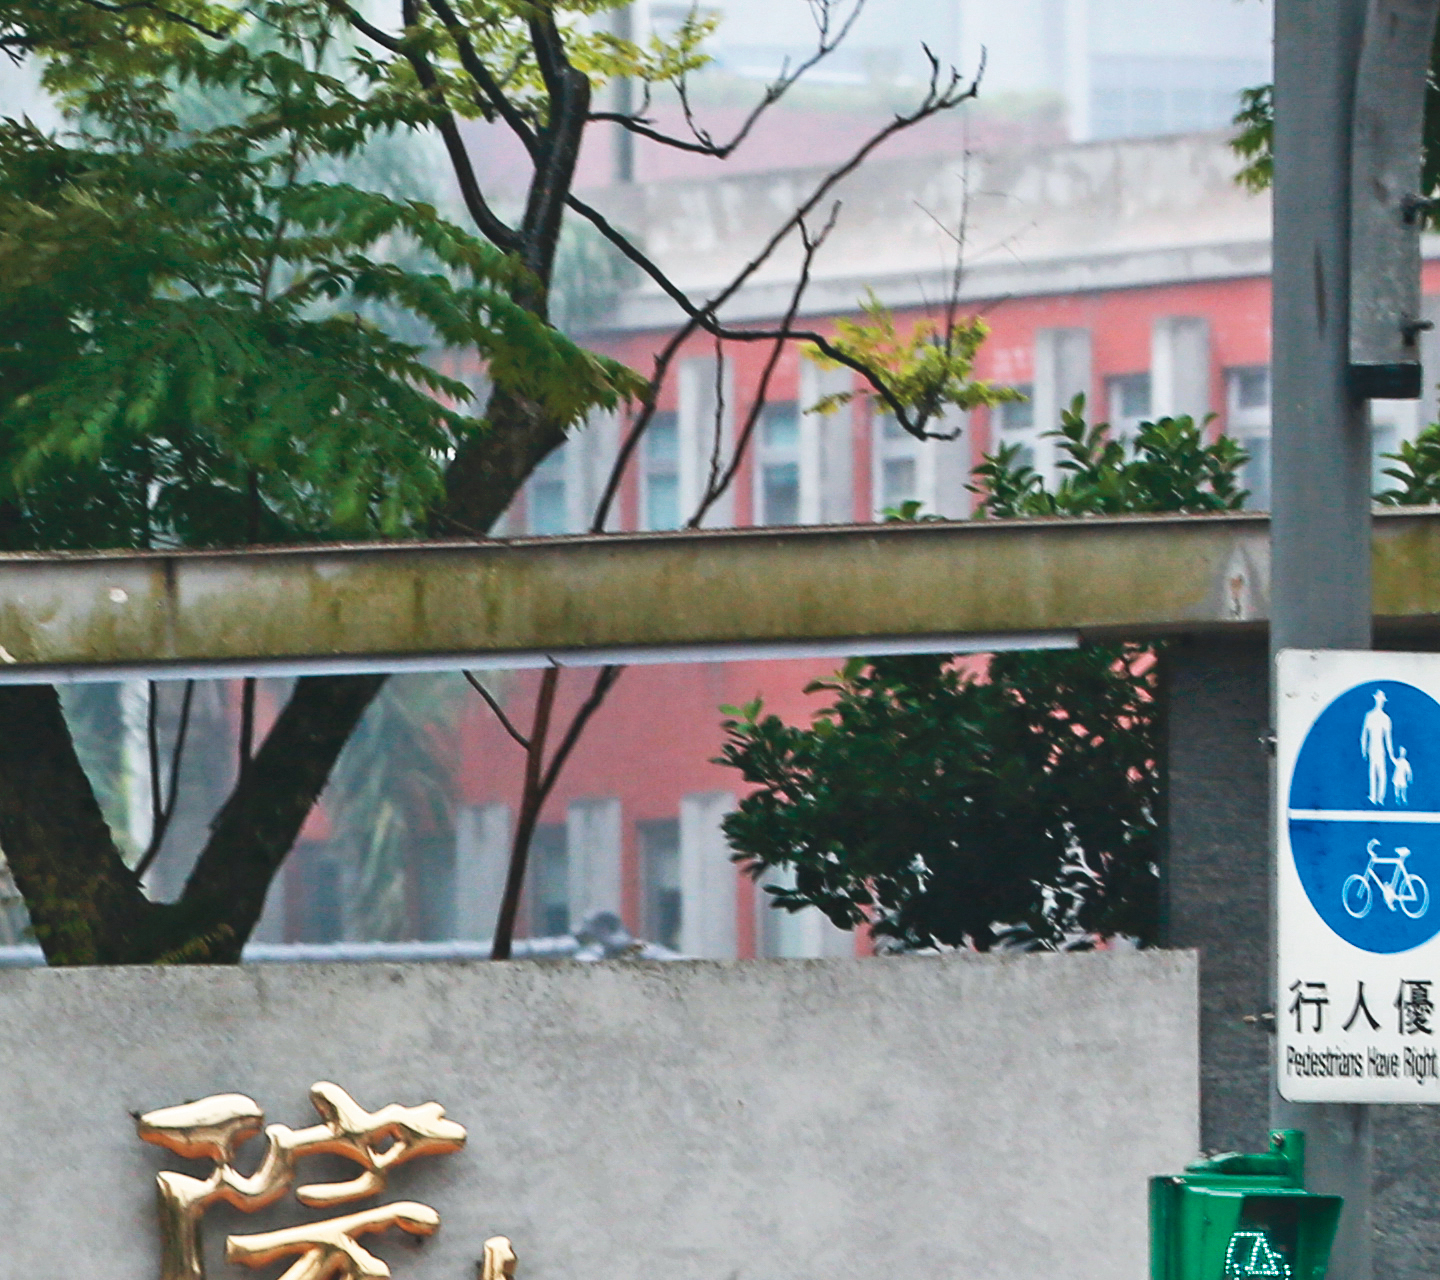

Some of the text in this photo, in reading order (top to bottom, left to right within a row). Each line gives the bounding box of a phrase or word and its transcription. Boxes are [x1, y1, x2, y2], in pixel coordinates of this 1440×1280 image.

[1288, 978, 1435, 1034] 行人優
[1287, 1045, 1439, 1085] Pedestrians Have Right
